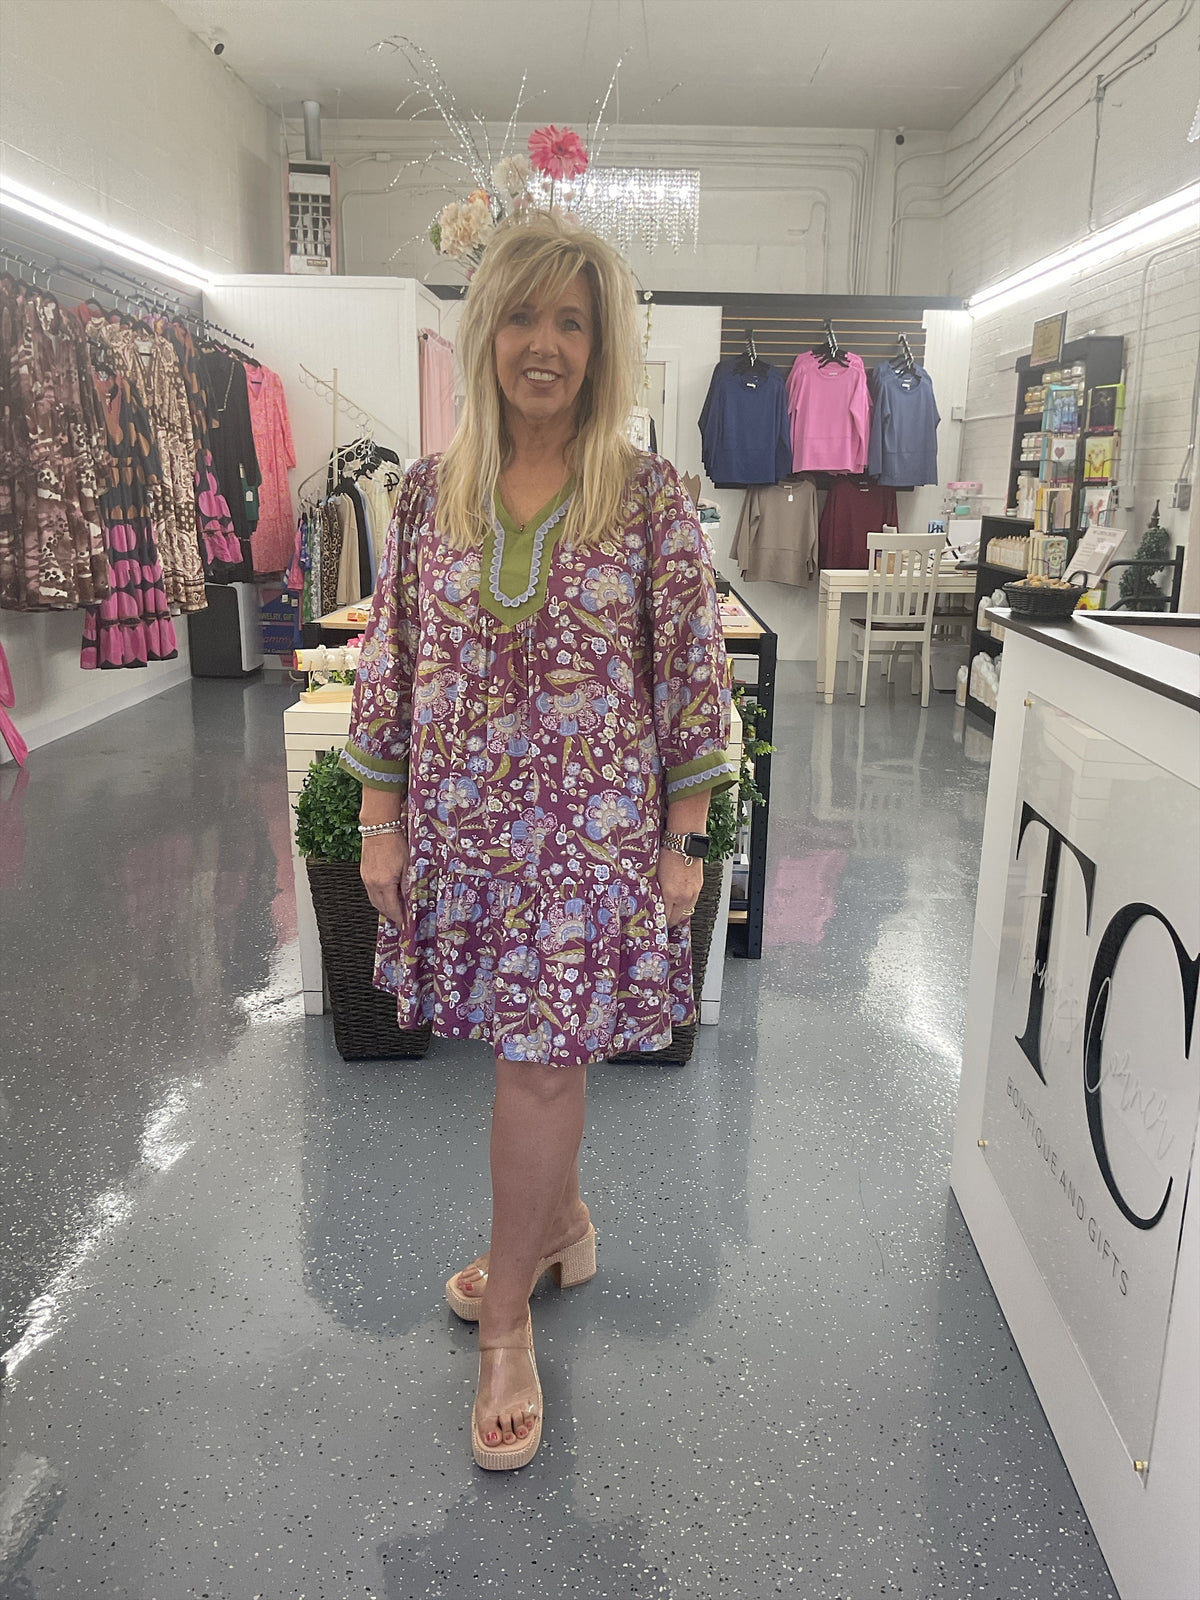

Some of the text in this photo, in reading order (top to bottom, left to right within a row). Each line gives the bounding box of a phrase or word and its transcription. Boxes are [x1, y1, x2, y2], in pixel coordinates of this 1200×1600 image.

[1006, 1075, 1129, 1296] BOUTIQUE AND GIFTS
